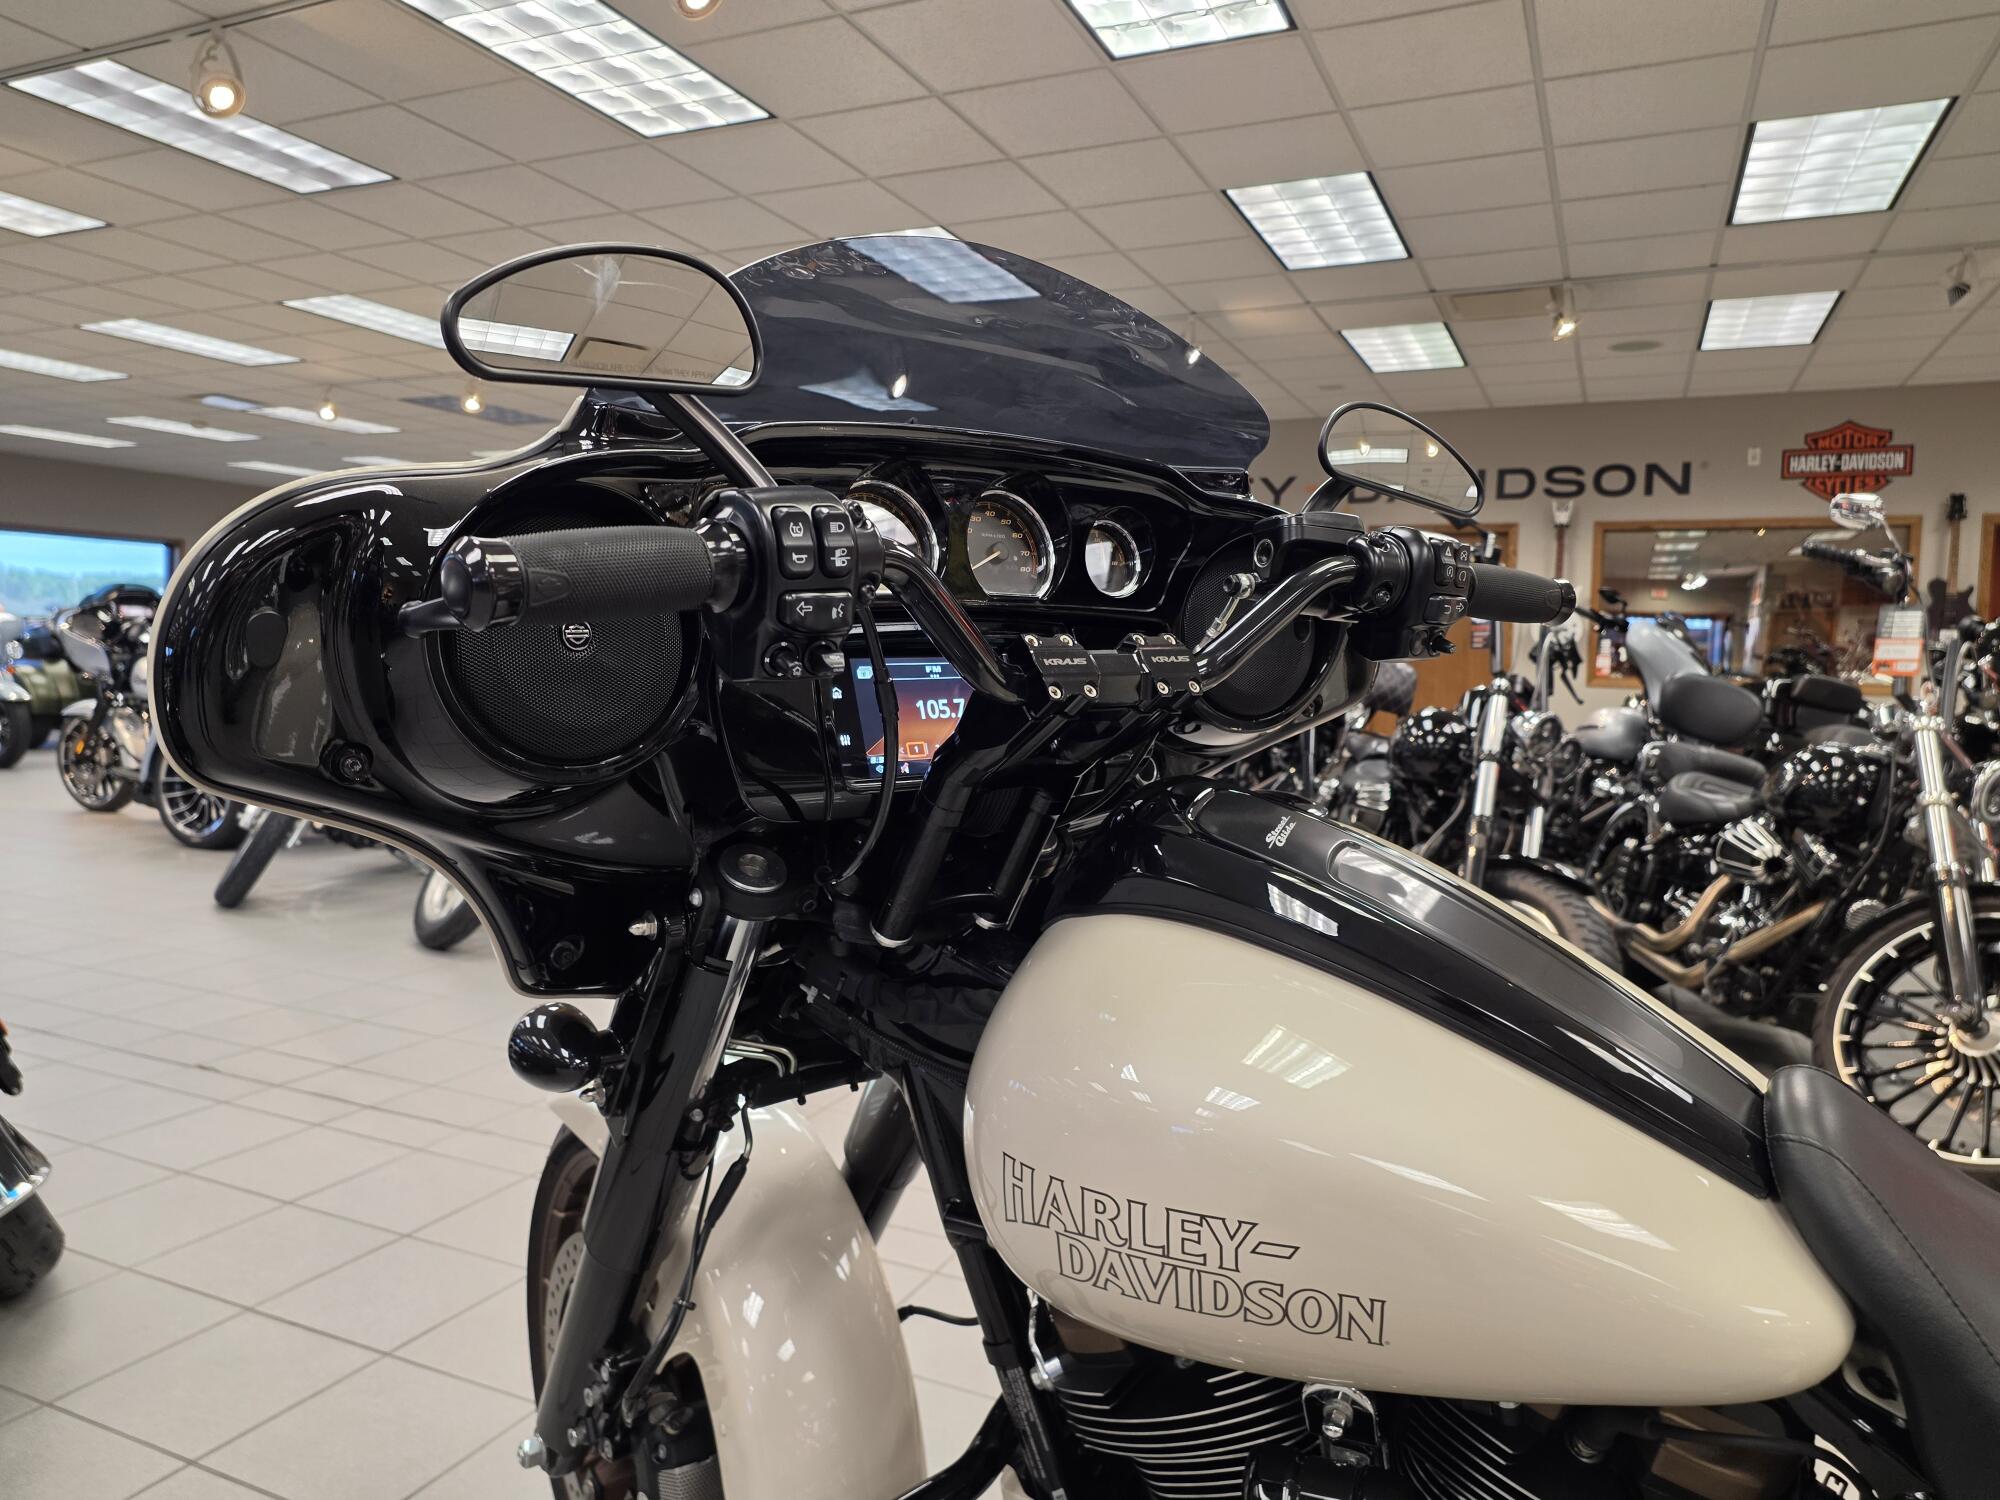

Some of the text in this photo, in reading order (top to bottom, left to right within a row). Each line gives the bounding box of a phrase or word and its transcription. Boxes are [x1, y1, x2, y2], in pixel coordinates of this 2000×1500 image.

[1817, 429, 1883, 449] MOTOR
[1789, 451, 1905, 473] HARLEY-DAVIDSON
[925, 665, 942, 673] FM
[1043, 657, 1088, 666] KRAUS
[1151, 655, 1190, 663] KRAUS
[915, 698, 965, 720] 105.7
[1275, 821, 1297, 847] Glide
[1002, 1152, 1300, 1272] HARLEY-
[1056, 1231, 1387, 1347] DAVIDSON
